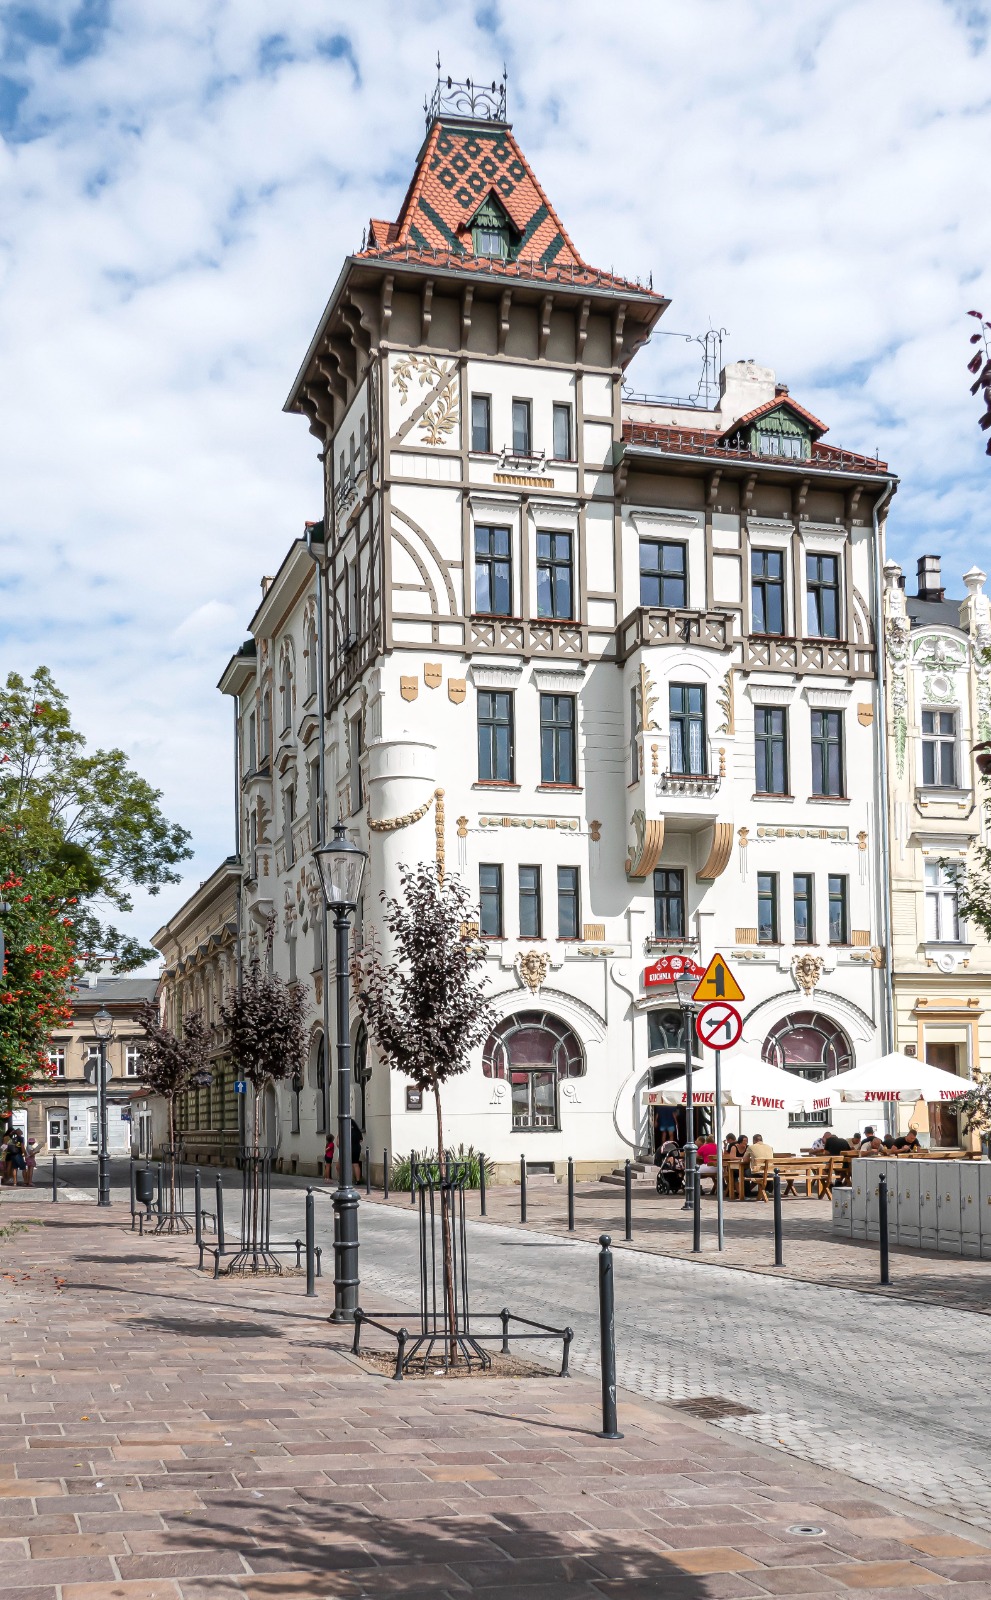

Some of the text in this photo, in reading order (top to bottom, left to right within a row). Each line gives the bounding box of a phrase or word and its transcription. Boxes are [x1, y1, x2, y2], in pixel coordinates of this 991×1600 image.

[681, 1092, 714, 1103] ŻWIEC
[864, 1090, 901, 1101] ŻYWIEC
[750, 1095, 785, 1110] ŻYWIEC
[812, 1097, 831, 1110] ŻYWIEC
